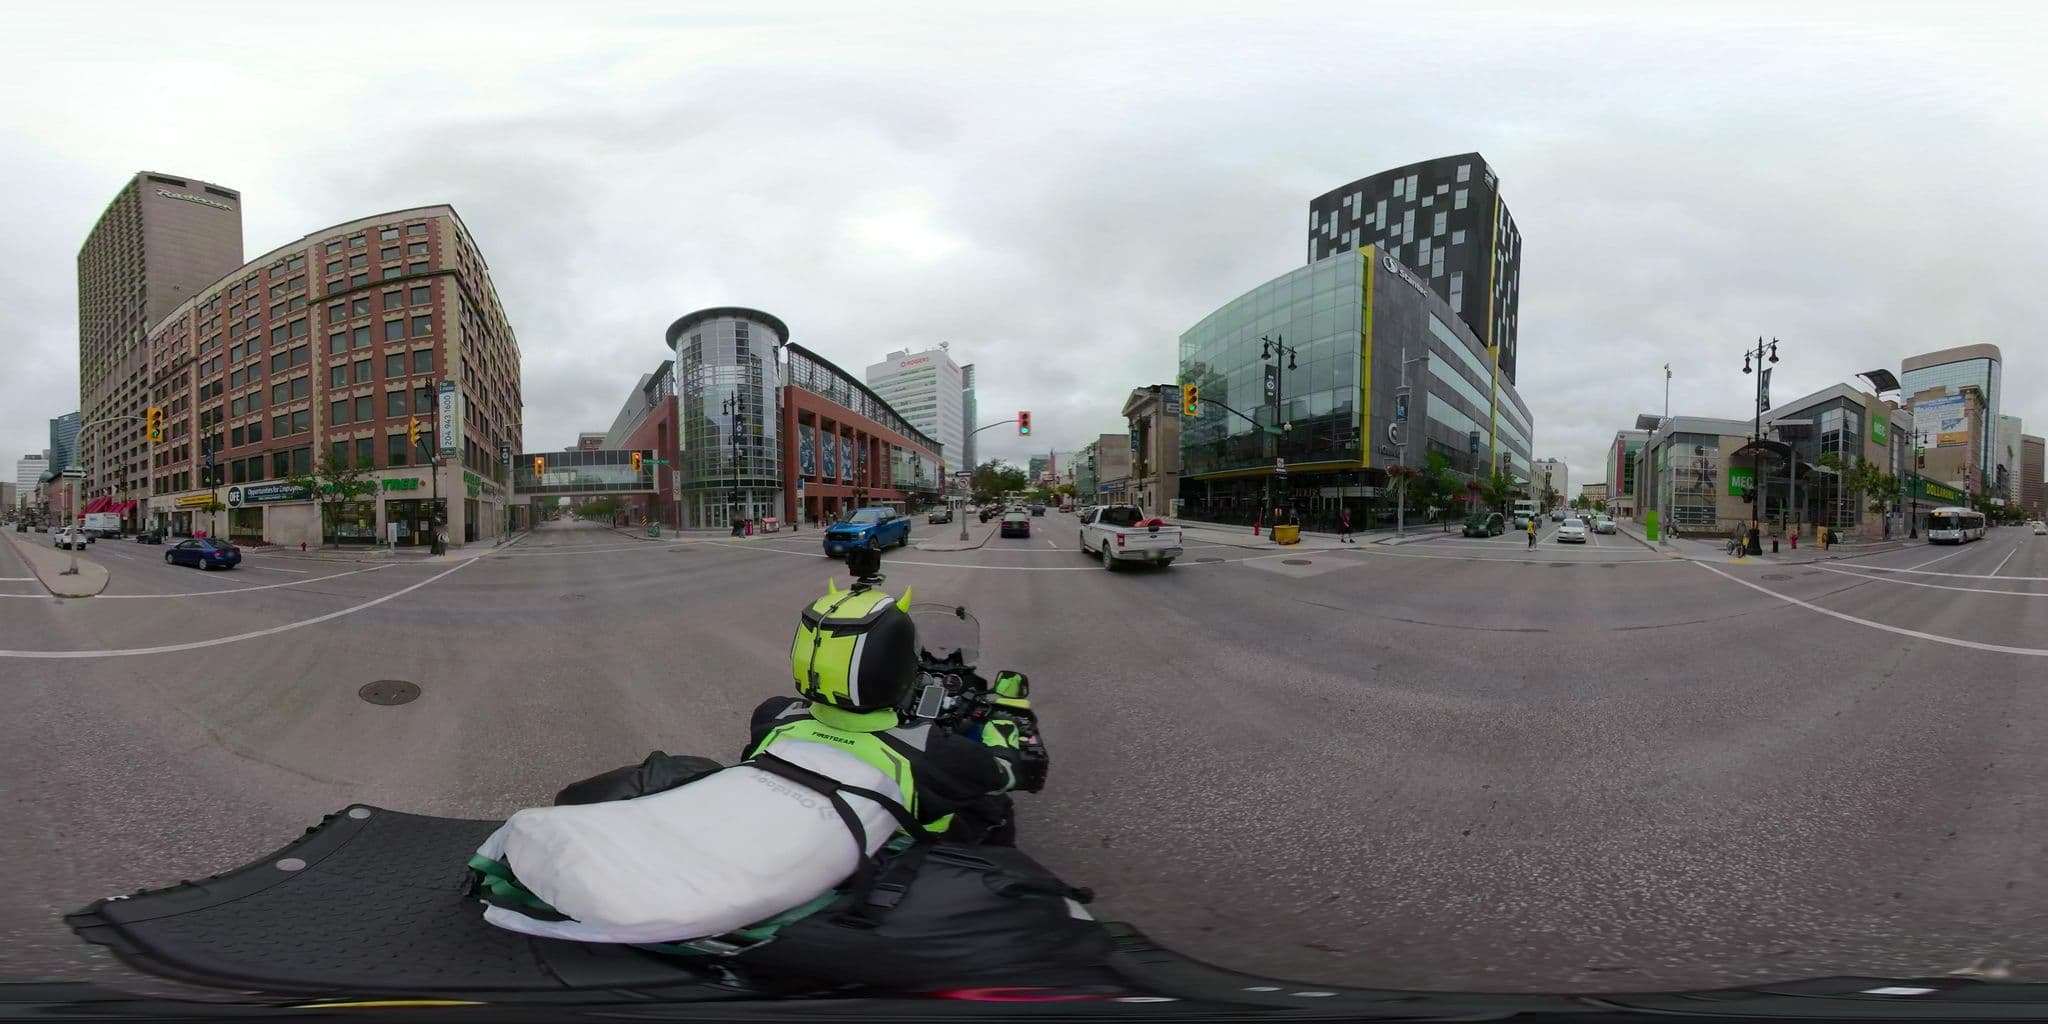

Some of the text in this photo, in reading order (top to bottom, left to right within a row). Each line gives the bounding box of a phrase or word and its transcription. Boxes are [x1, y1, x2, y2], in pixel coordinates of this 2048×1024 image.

[382, 478, 418, 491] TREE
[229, 491, 240, 502] OFE
[811, 731, 855, 746] FIRSTGEAR
